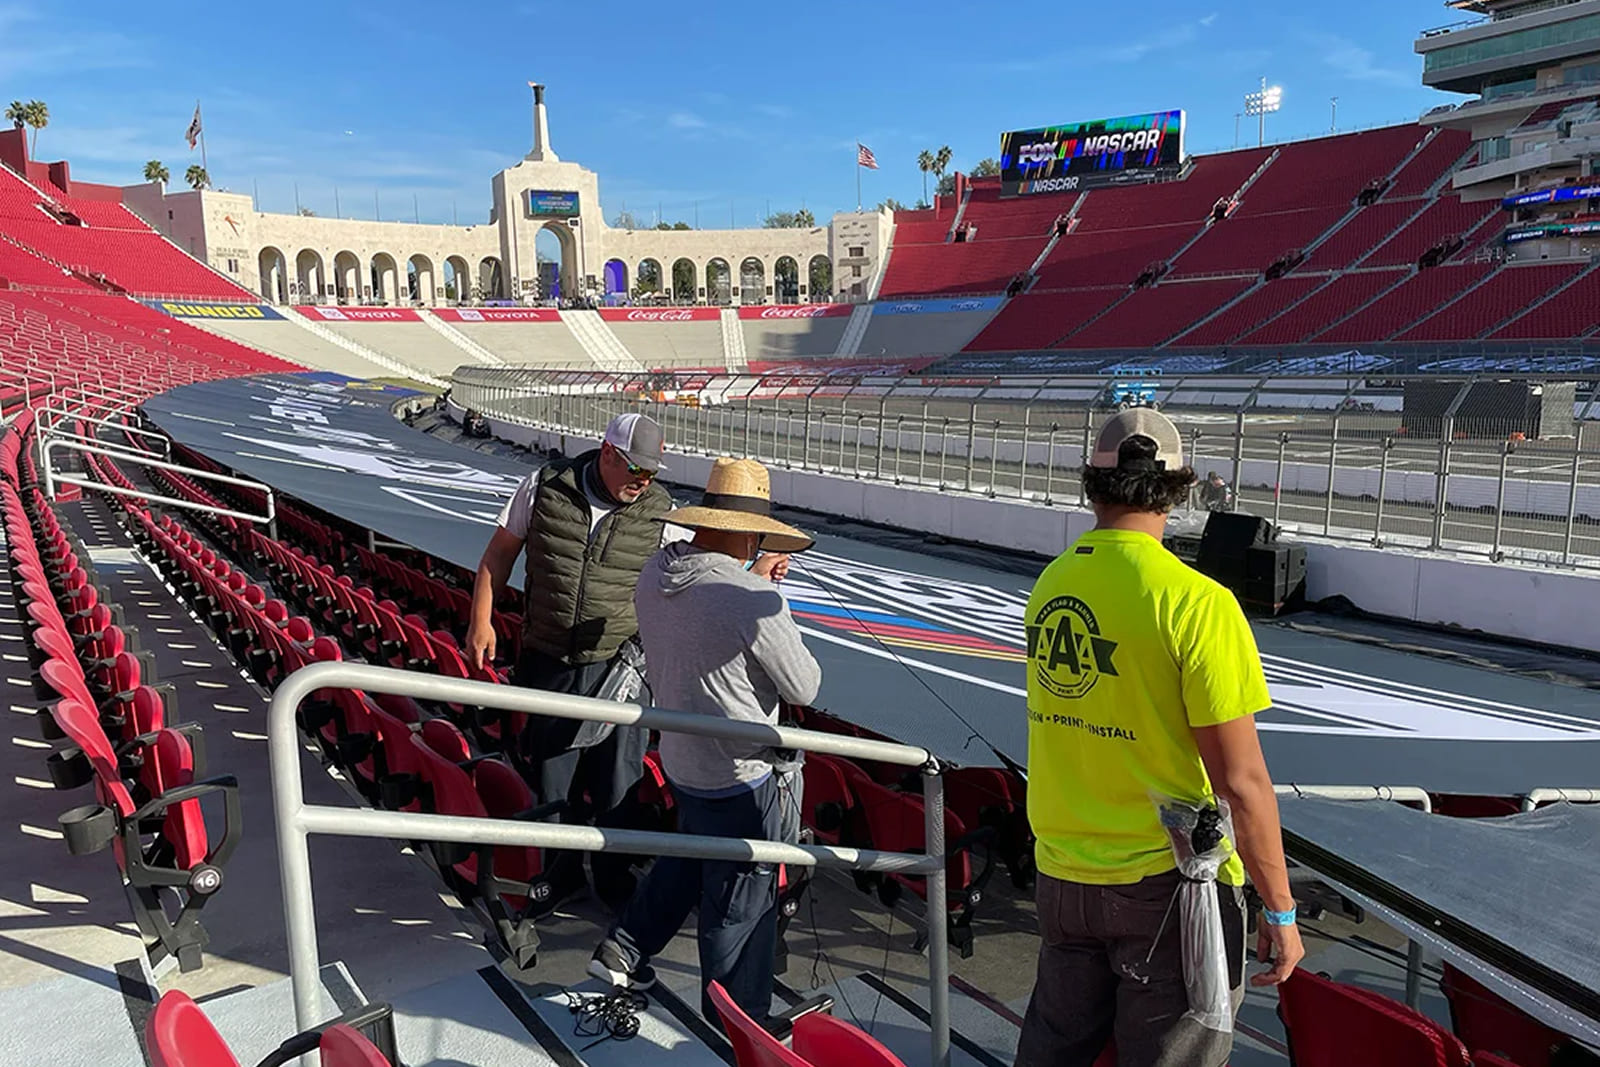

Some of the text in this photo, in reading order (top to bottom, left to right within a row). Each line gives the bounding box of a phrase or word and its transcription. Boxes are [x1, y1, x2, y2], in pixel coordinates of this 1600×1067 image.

[1018, 129, 1160, 164] FOX NASCAR
[1032, 176, 1079, 193] NASCAR
[162, 302, 265, 318] SUNOCO
[345, 311, 402, 319] TOYOTA
[197, 873, 215, 888] 16
[536, 886, 549, 897] 15
